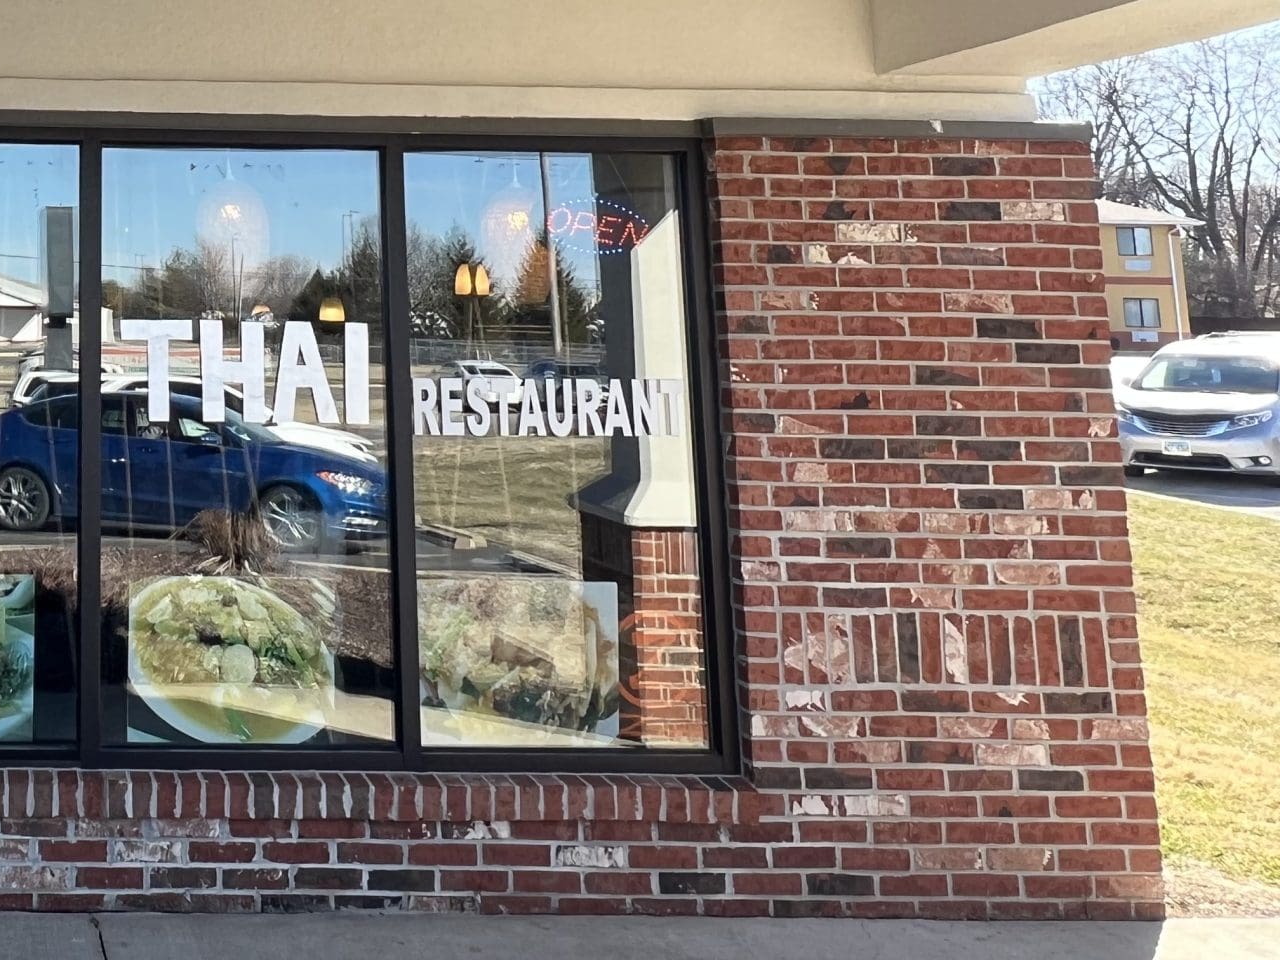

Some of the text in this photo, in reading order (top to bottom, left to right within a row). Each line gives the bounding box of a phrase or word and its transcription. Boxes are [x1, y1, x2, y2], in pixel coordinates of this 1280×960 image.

[546, 206, 650, 246] OPEN
[120, 319, 370, 426] THAI
[410, 376, 684, 438] RESTAURANT
